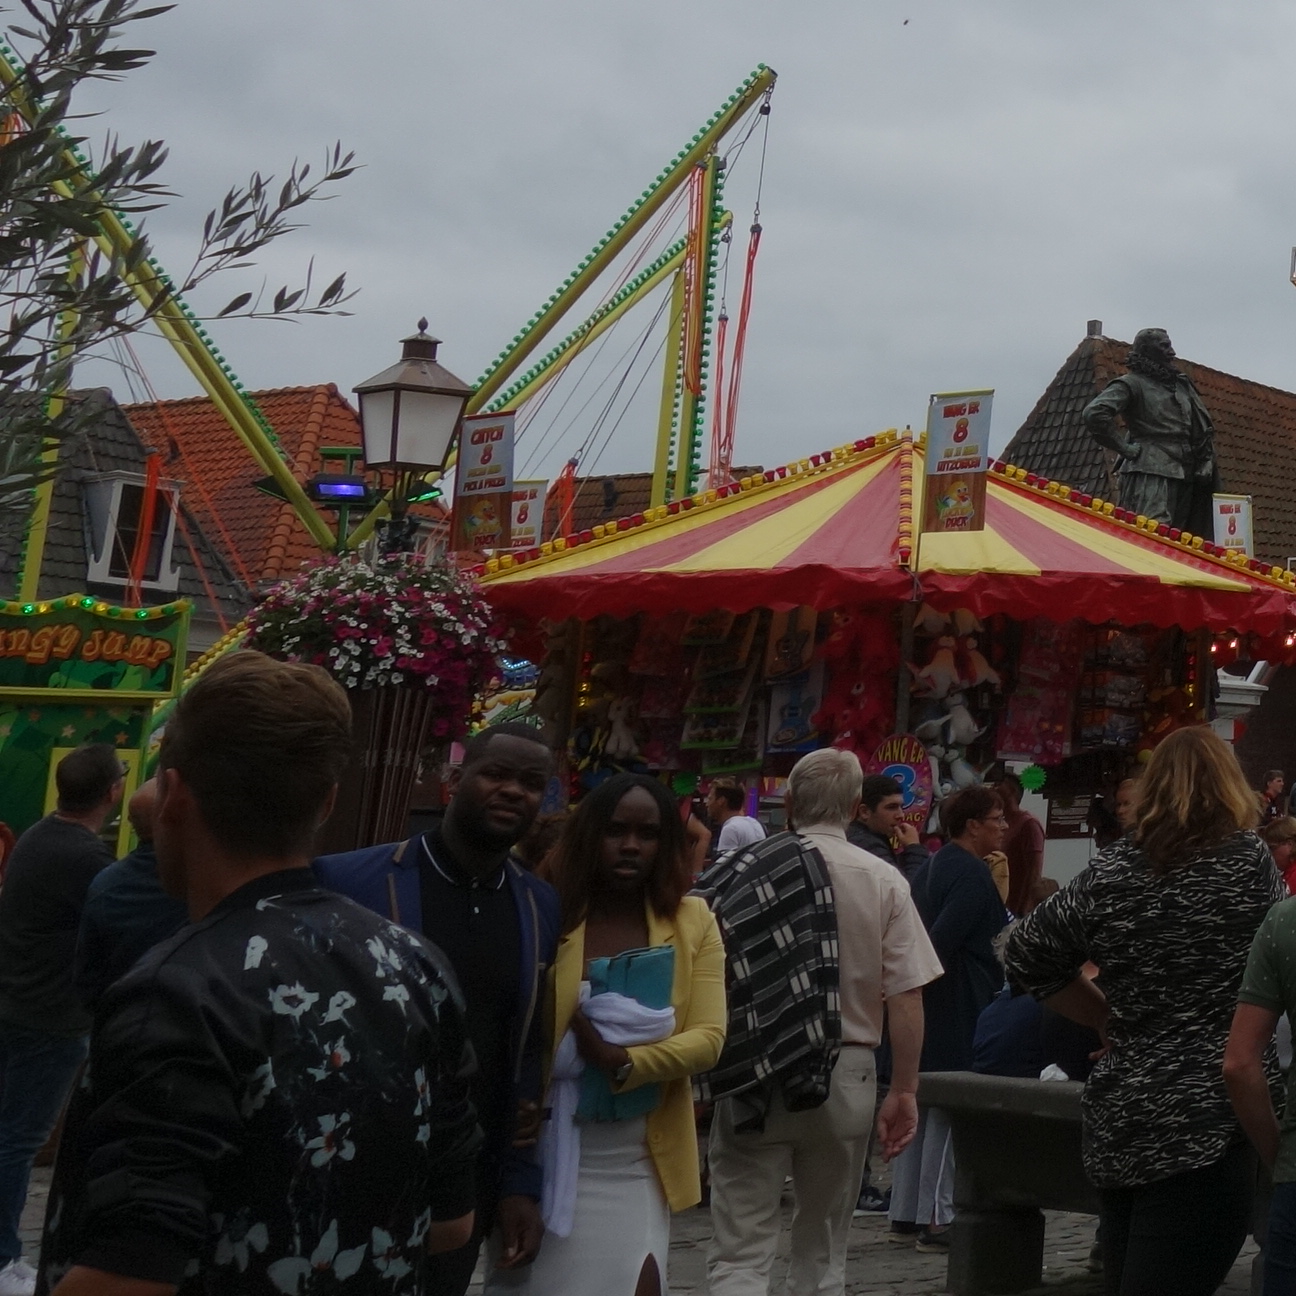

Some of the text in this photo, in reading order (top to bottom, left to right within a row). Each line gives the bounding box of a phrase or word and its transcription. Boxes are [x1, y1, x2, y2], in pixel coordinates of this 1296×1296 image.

[953, 418, 969, 443] 8
[481, 444, 493, 464] 8
[517, 503, 529, 524] 8
[945, 517, 968, 528] DUCK
[1228, 516, 1236, 535] 8
[81, 628, 173, 669] JUMP
[876, 737, 925, 763] VANG ER
